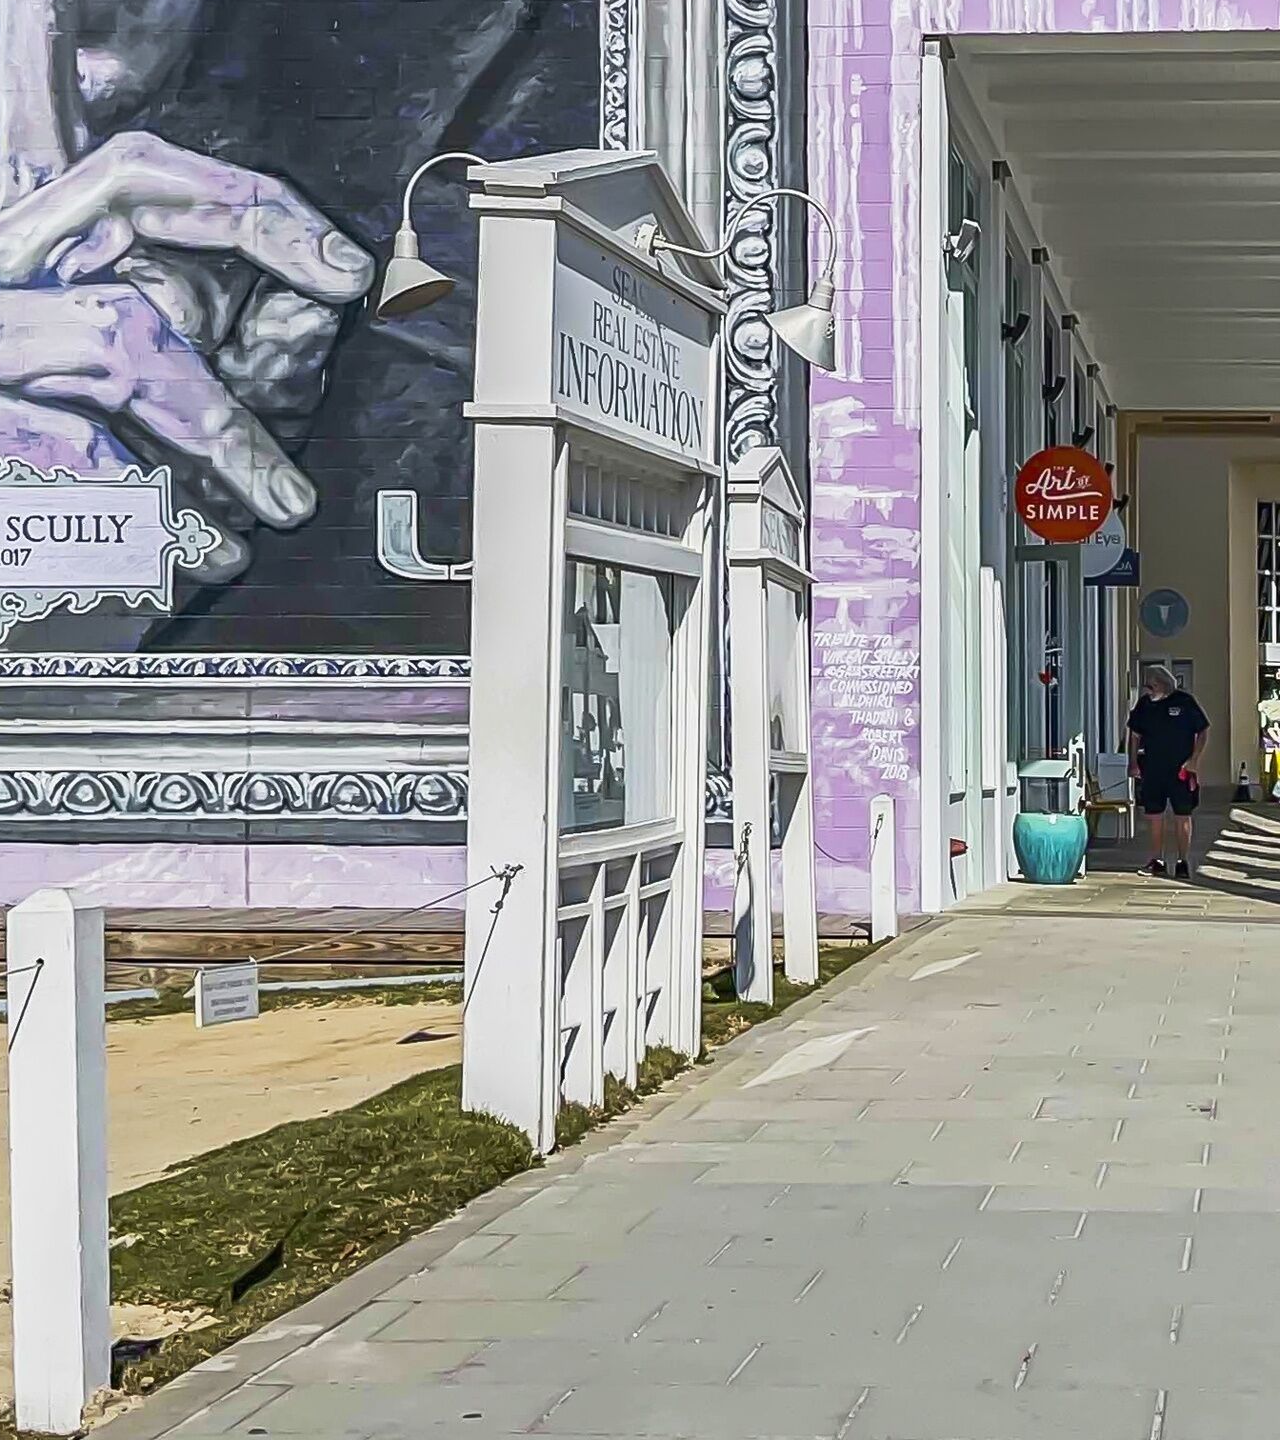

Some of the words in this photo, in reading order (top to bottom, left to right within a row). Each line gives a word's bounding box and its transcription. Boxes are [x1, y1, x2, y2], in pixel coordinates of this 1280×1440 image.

[593, 300, 629, 355] REAL
[634, 323, 680, 380] ESTATE
[558, 331, 703, 450] INFORMATION
[1025, 466, 1078, 499] Art
[1026, 504, 1099, 520] SIMPLE
[6, 514, 133, 543] SCULLY
[1095, 531, 1121, 547] Eye
[814, 632, 867, 648] TRIBUTE
[873, 634, 893, 648] TO
[871, 744, 905, 762] DAVIS
[880, 763, 910, 780] 2018
